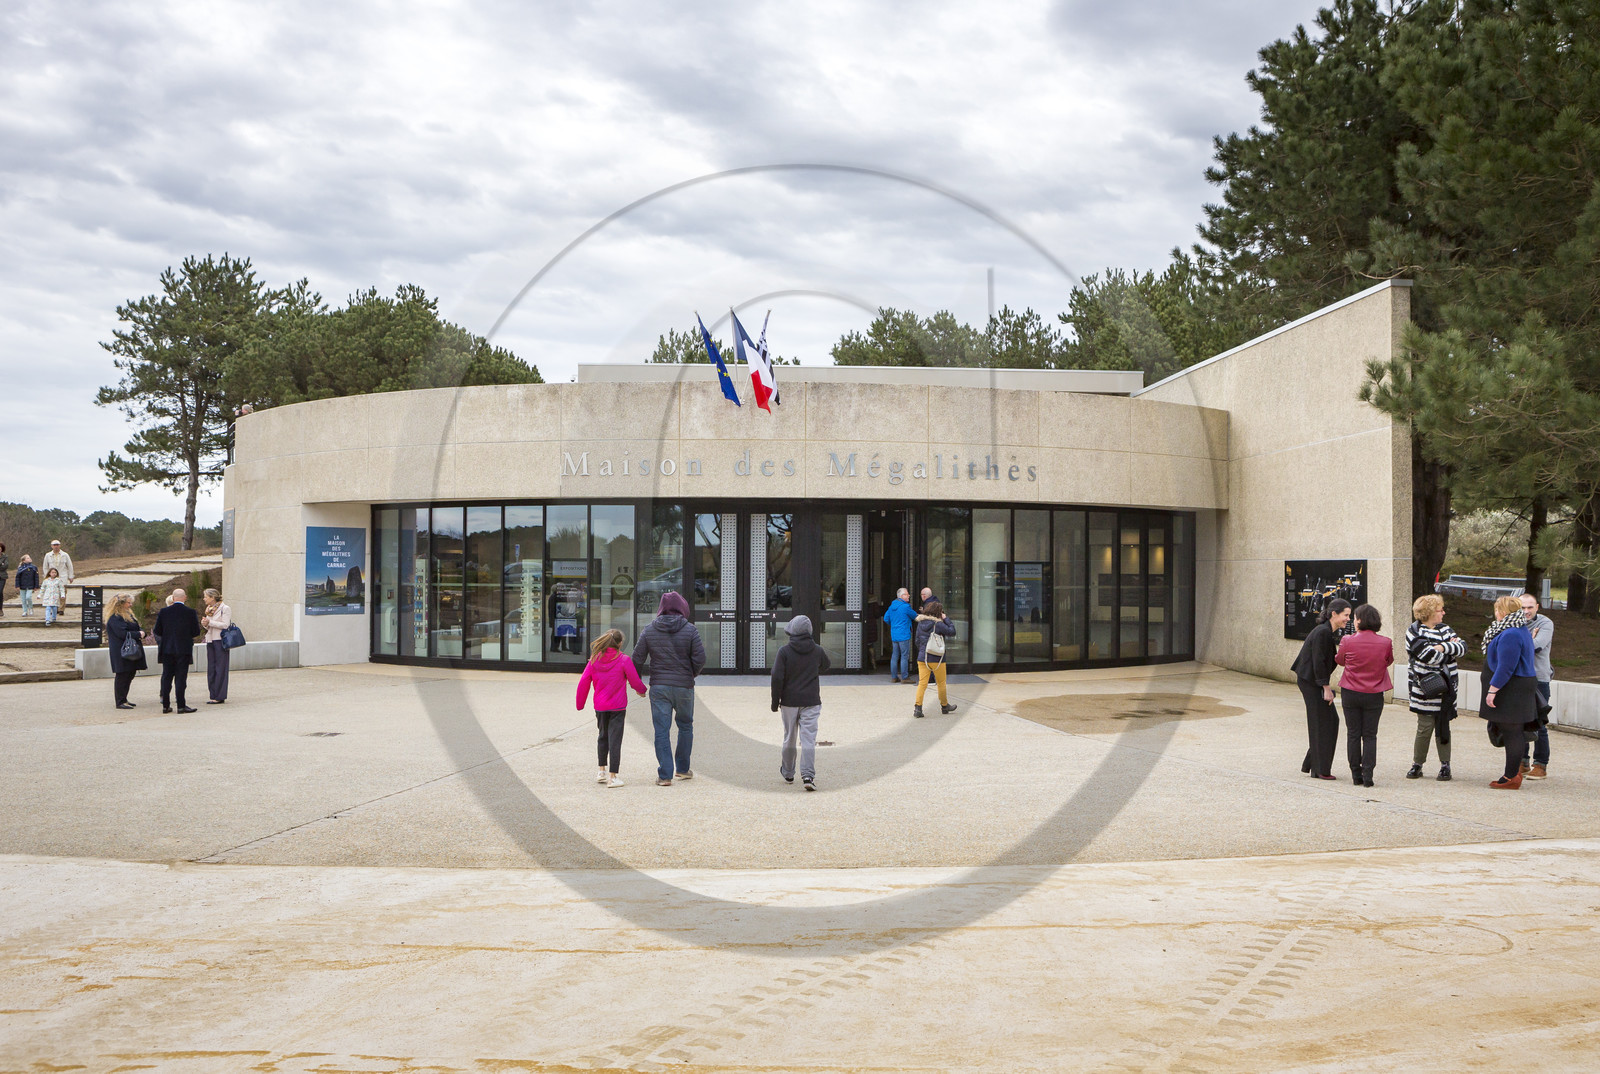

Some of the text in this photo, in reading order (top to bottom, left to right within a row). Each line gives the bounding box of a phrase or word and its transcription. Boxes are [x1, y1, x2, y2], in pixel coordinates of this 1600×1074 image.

[560, 449, 1038, 486] Maison des Mégalithes
